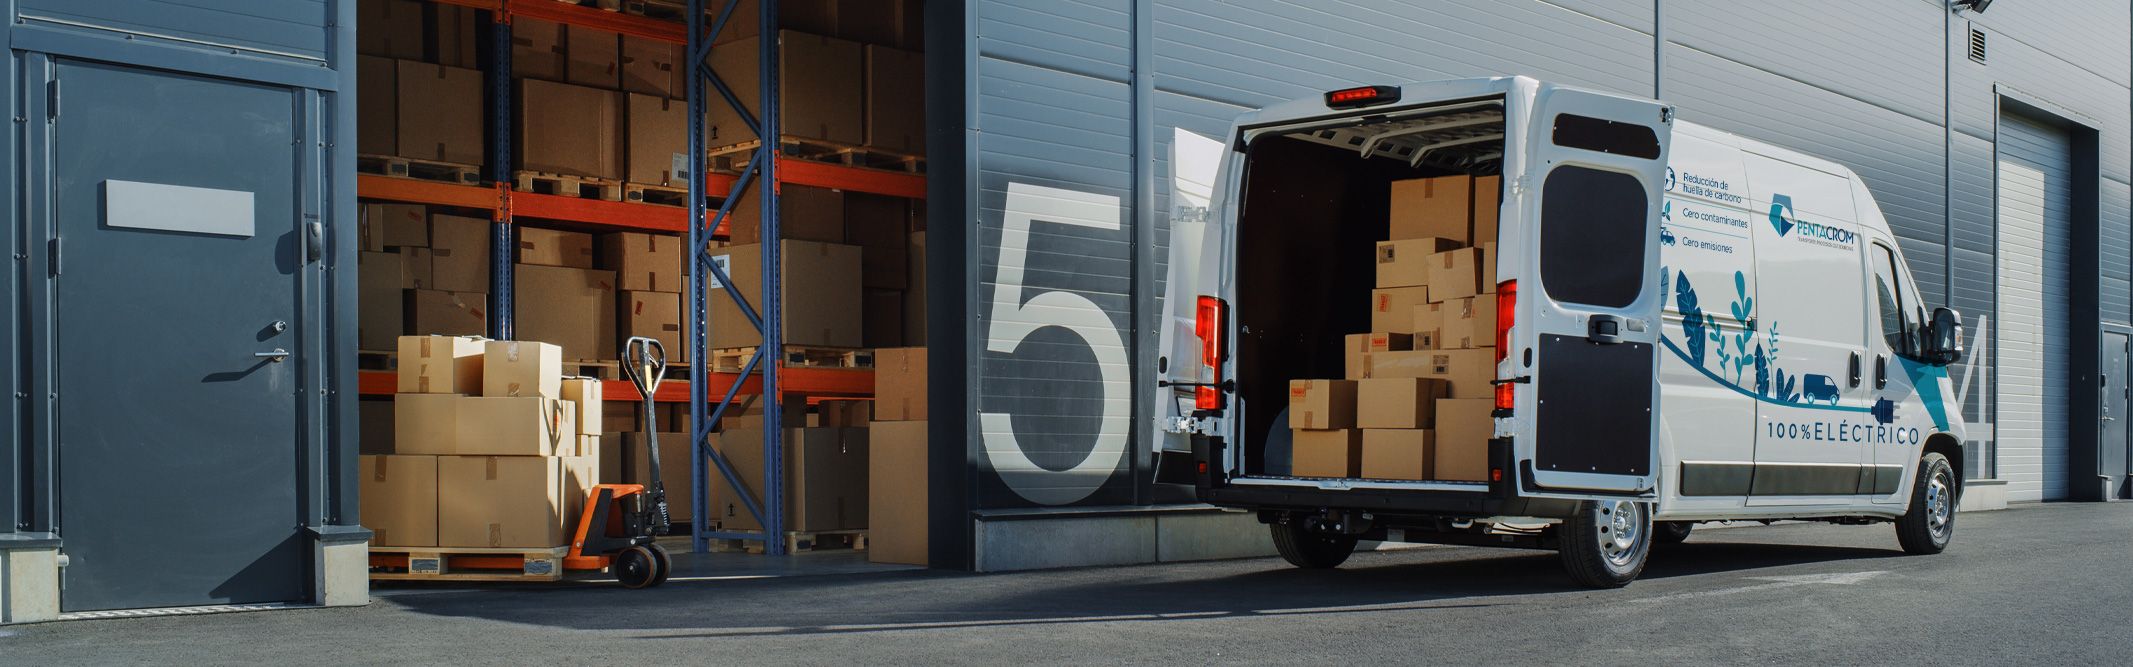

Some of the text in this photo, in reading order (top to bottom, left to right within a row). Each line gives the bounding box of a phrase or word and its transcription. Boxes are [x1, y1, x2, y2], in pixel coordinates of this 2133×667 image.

[1683, 172, 1729, 190] Reducción de
[1683, 183, 1741, 203] huella de carbono
[1682, 207, 1748, 229] Cero contaminantes
[1797, 219, 1854, 245] PENTACROM
[1682, 236, 1733, 254] Cero emisiones
[980, 181, 1131, 505] 5
[1956, 314, 1994, 480] 4
